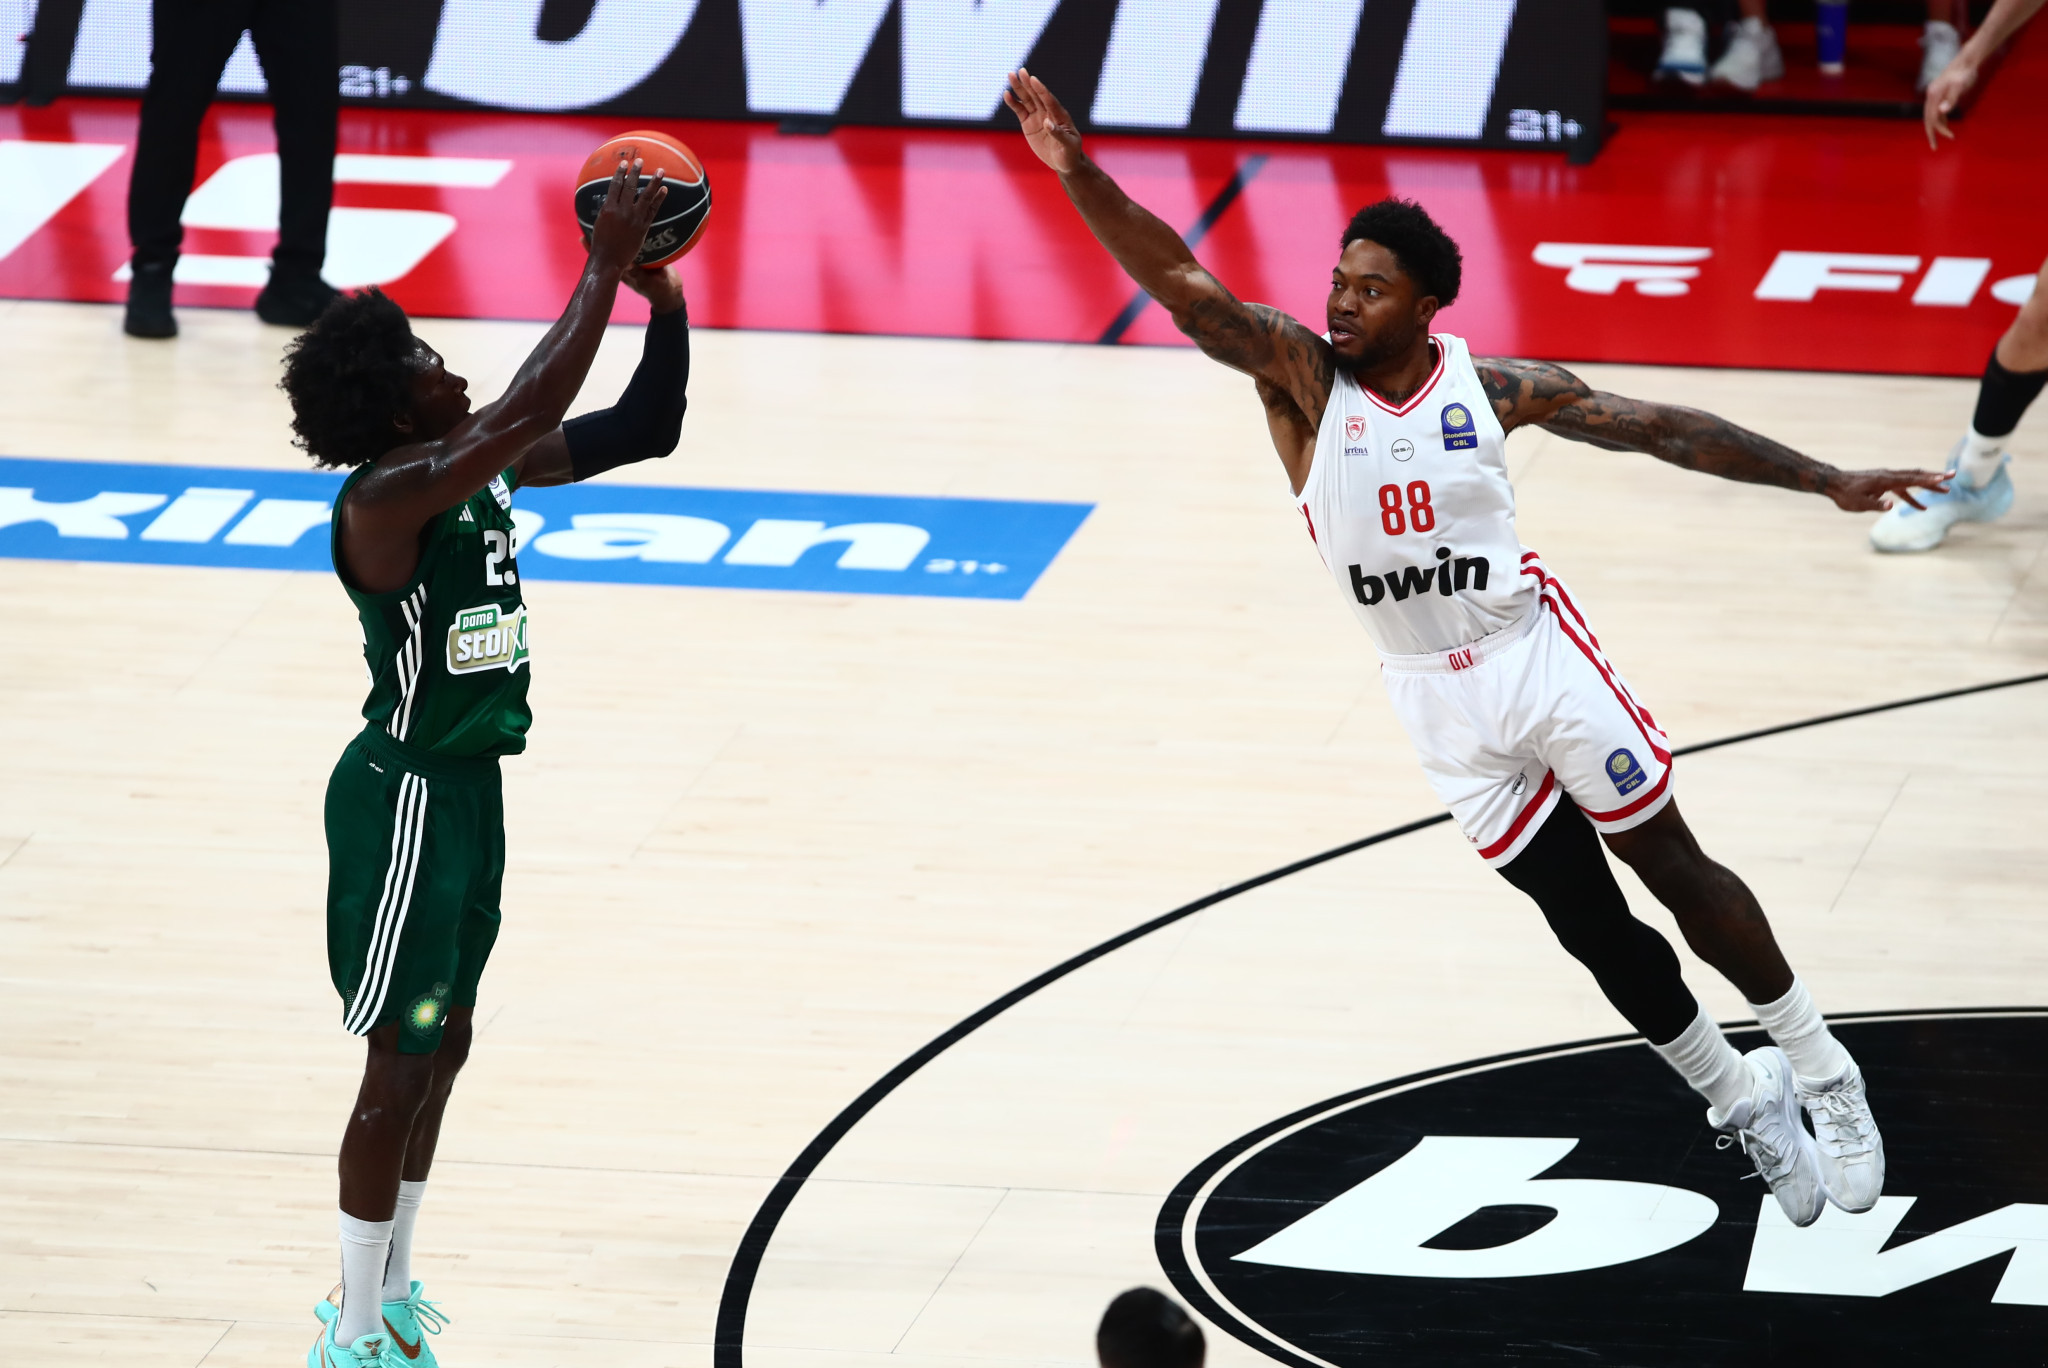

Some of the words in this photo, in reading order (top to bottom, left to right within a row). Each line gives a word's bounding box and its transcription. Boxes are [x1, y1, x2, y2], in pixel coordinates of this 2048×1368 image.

[339, 65, 412, 97] 21+
[1506, 109, 1584, 142] 21+
[1453, 439, 1470, 447] GBL
[1378, 480, 1435, 536] 88
[1348, 546, 1490, 606] bwin
[462, 612, 494, 630] pame
[1448, 648, 1473, 671] OLY
